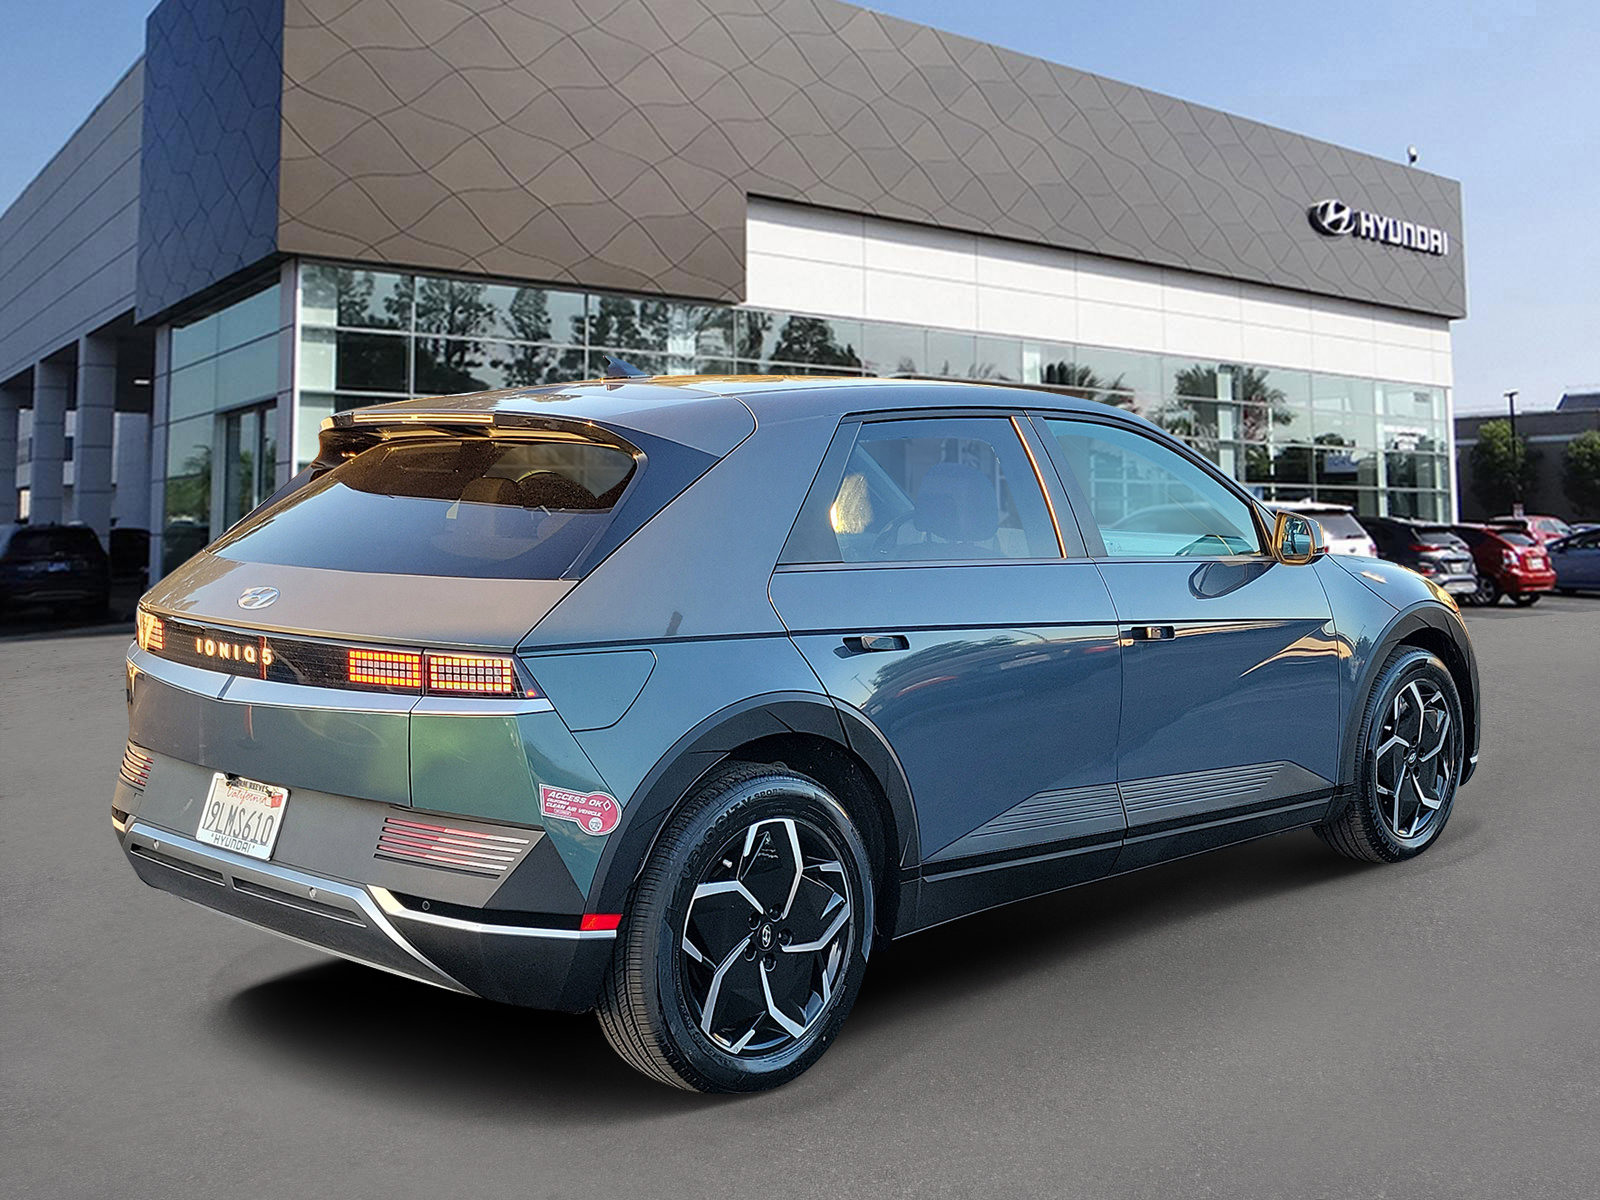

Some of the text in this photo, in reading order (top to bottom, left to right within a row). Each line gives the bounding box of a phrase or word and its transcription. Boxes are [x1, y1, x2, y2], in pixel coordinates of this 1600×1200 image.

[1360, 211, 1449, 255] HYUNDAI
[196, 637, 274, 665] IONIQ 5
[249, 782, 268, 792] REEVES
[548, 791, 604, 808] ACCESS OK
[545, 802, 566, 810] CLEAN
[566, 805, 578, 813] AIR
[578, 808, 602, 817] VEHICLE
[206, 800, 275, 847] 9LMS610
[214, 834, 251, 853] HYUNDAI
